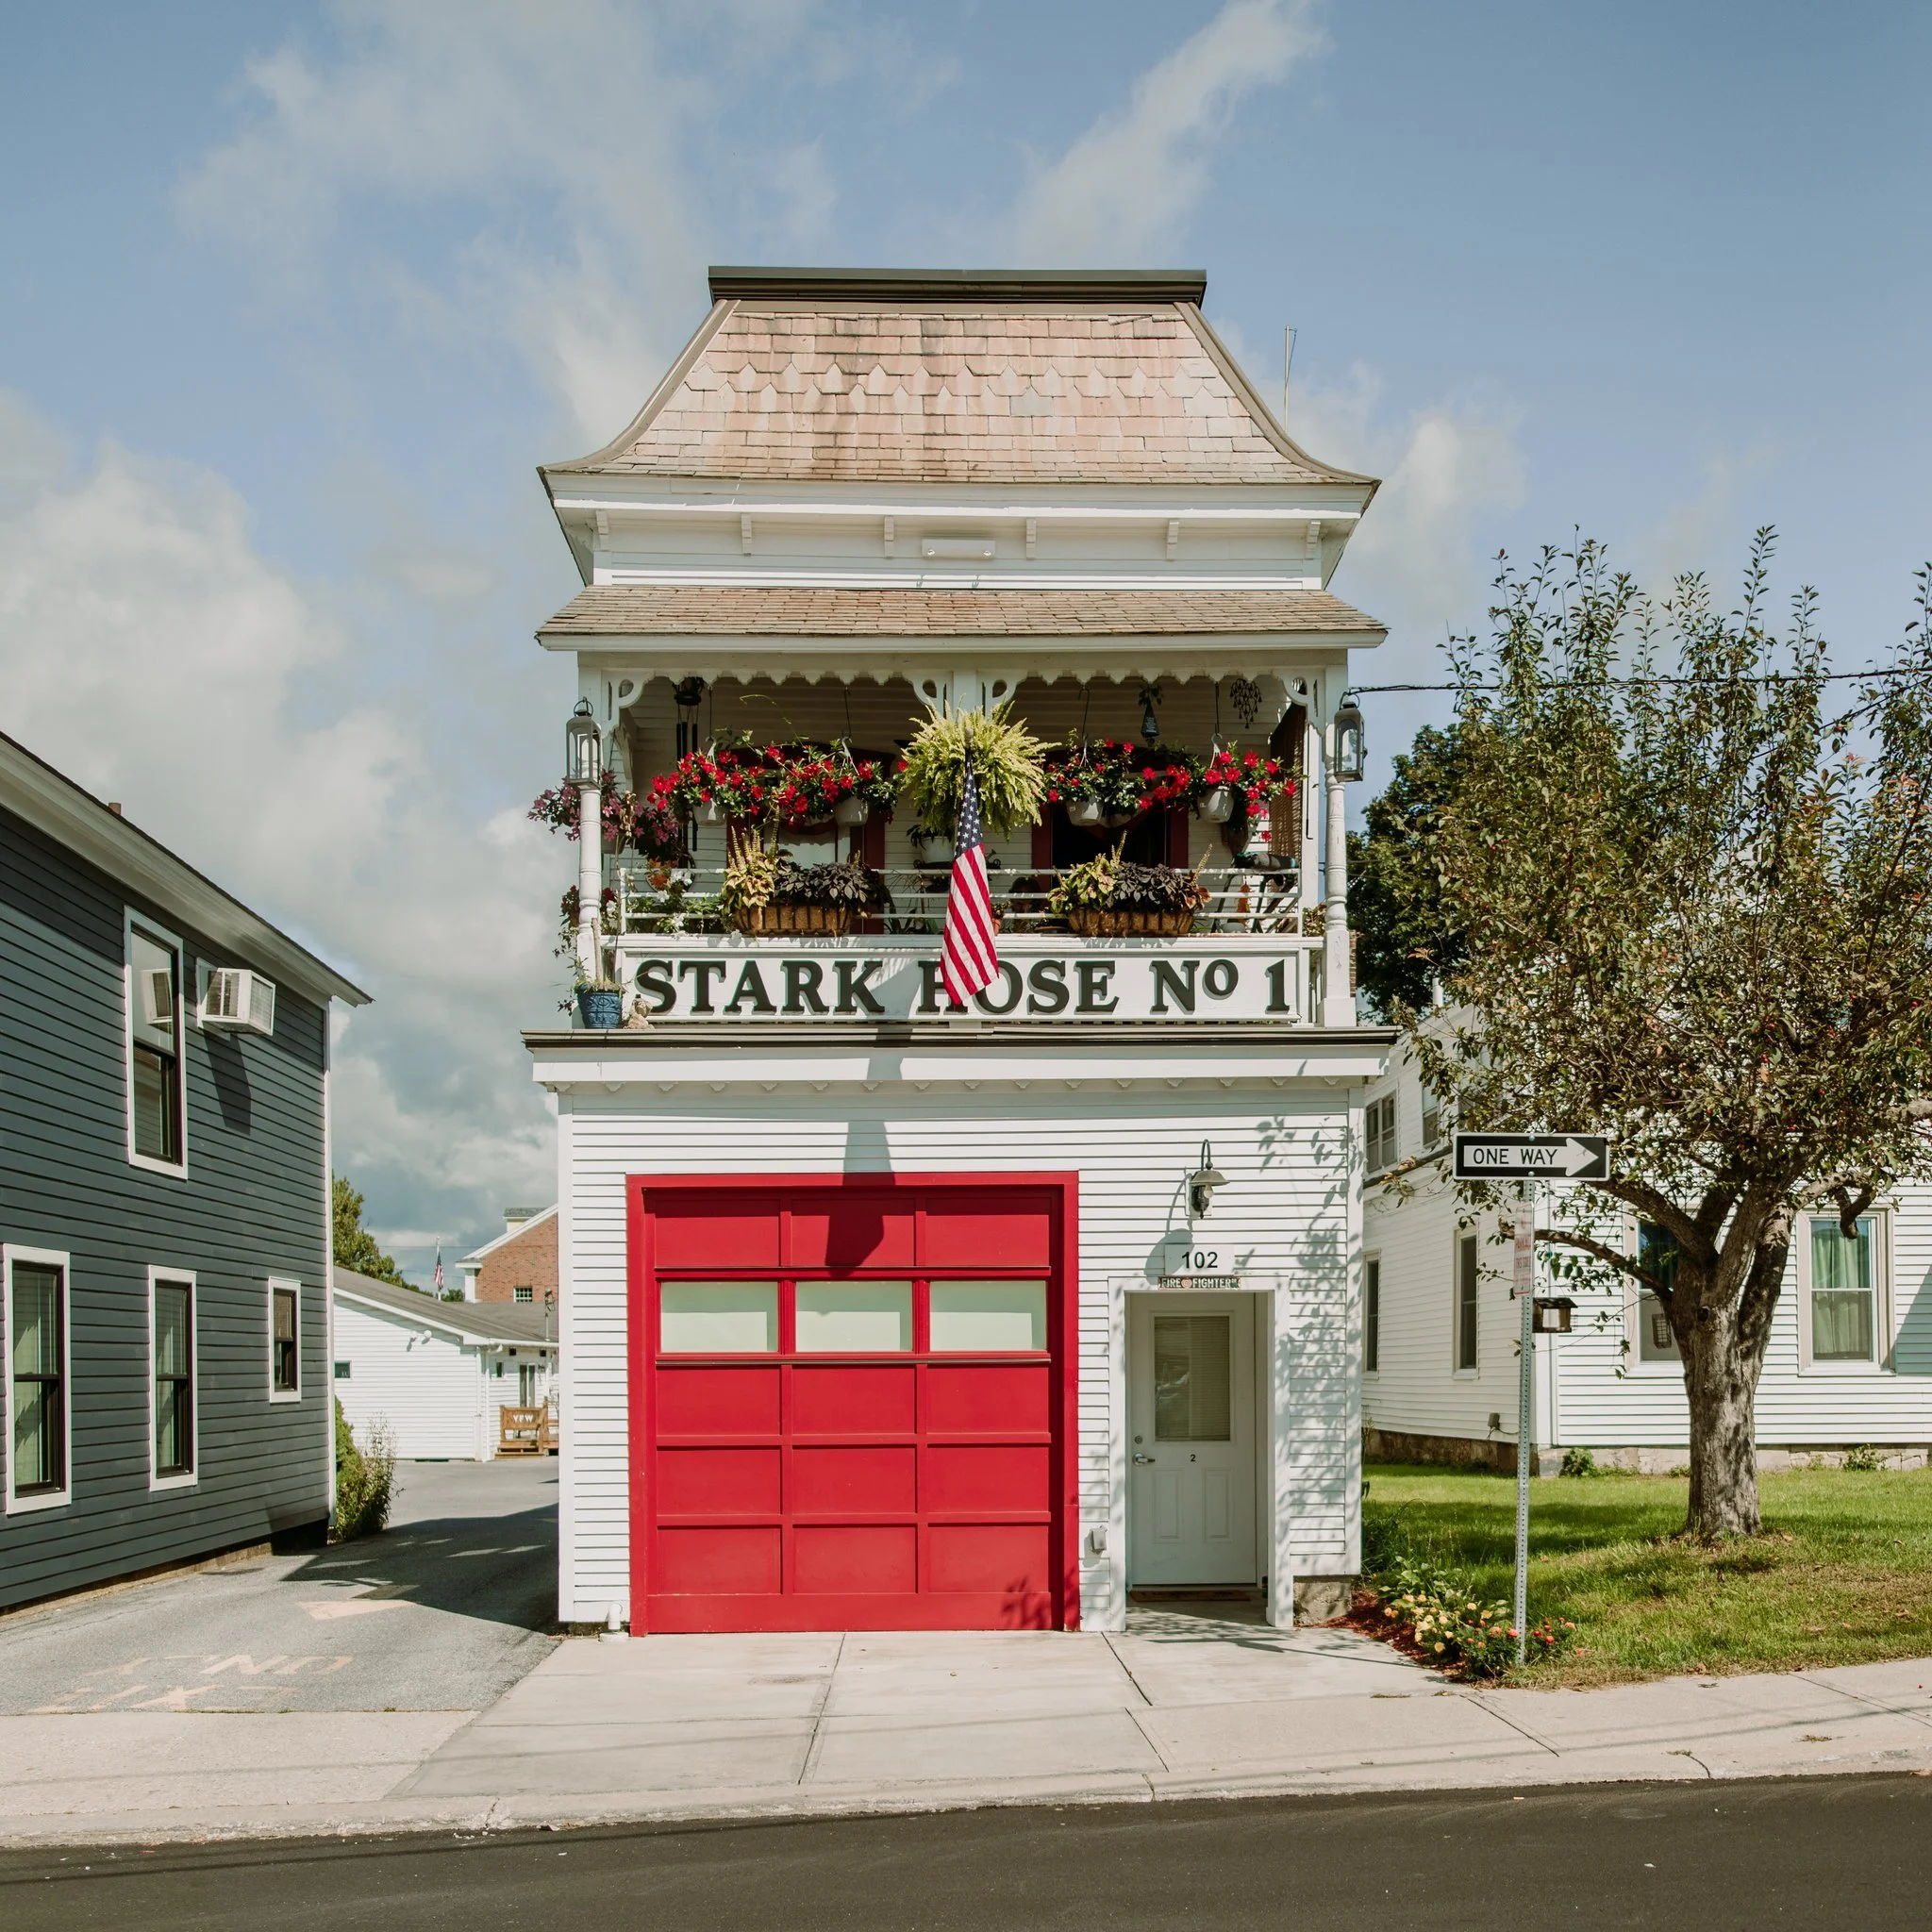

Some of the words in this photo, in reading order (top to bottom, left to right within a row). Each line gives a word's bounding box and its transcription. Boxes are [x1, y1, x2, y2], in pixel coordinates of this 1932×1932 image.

[635, 958, 885, 1014] STARK
[917, 958, 1120, 1014] HOSE
[1266, 958, 1290, 1012] 1
[1473, 1148, 1509, 1165] ONE
[1521, 1148, 1558, 1165] WAY
[1181, 1251, 1218, 1269] 102
[1161, 1277, 1182, 1288] FIRE
[1192, 1277, 1231, 1288] FIGHTER
[1191, 1454, 1196, 1462] 2
